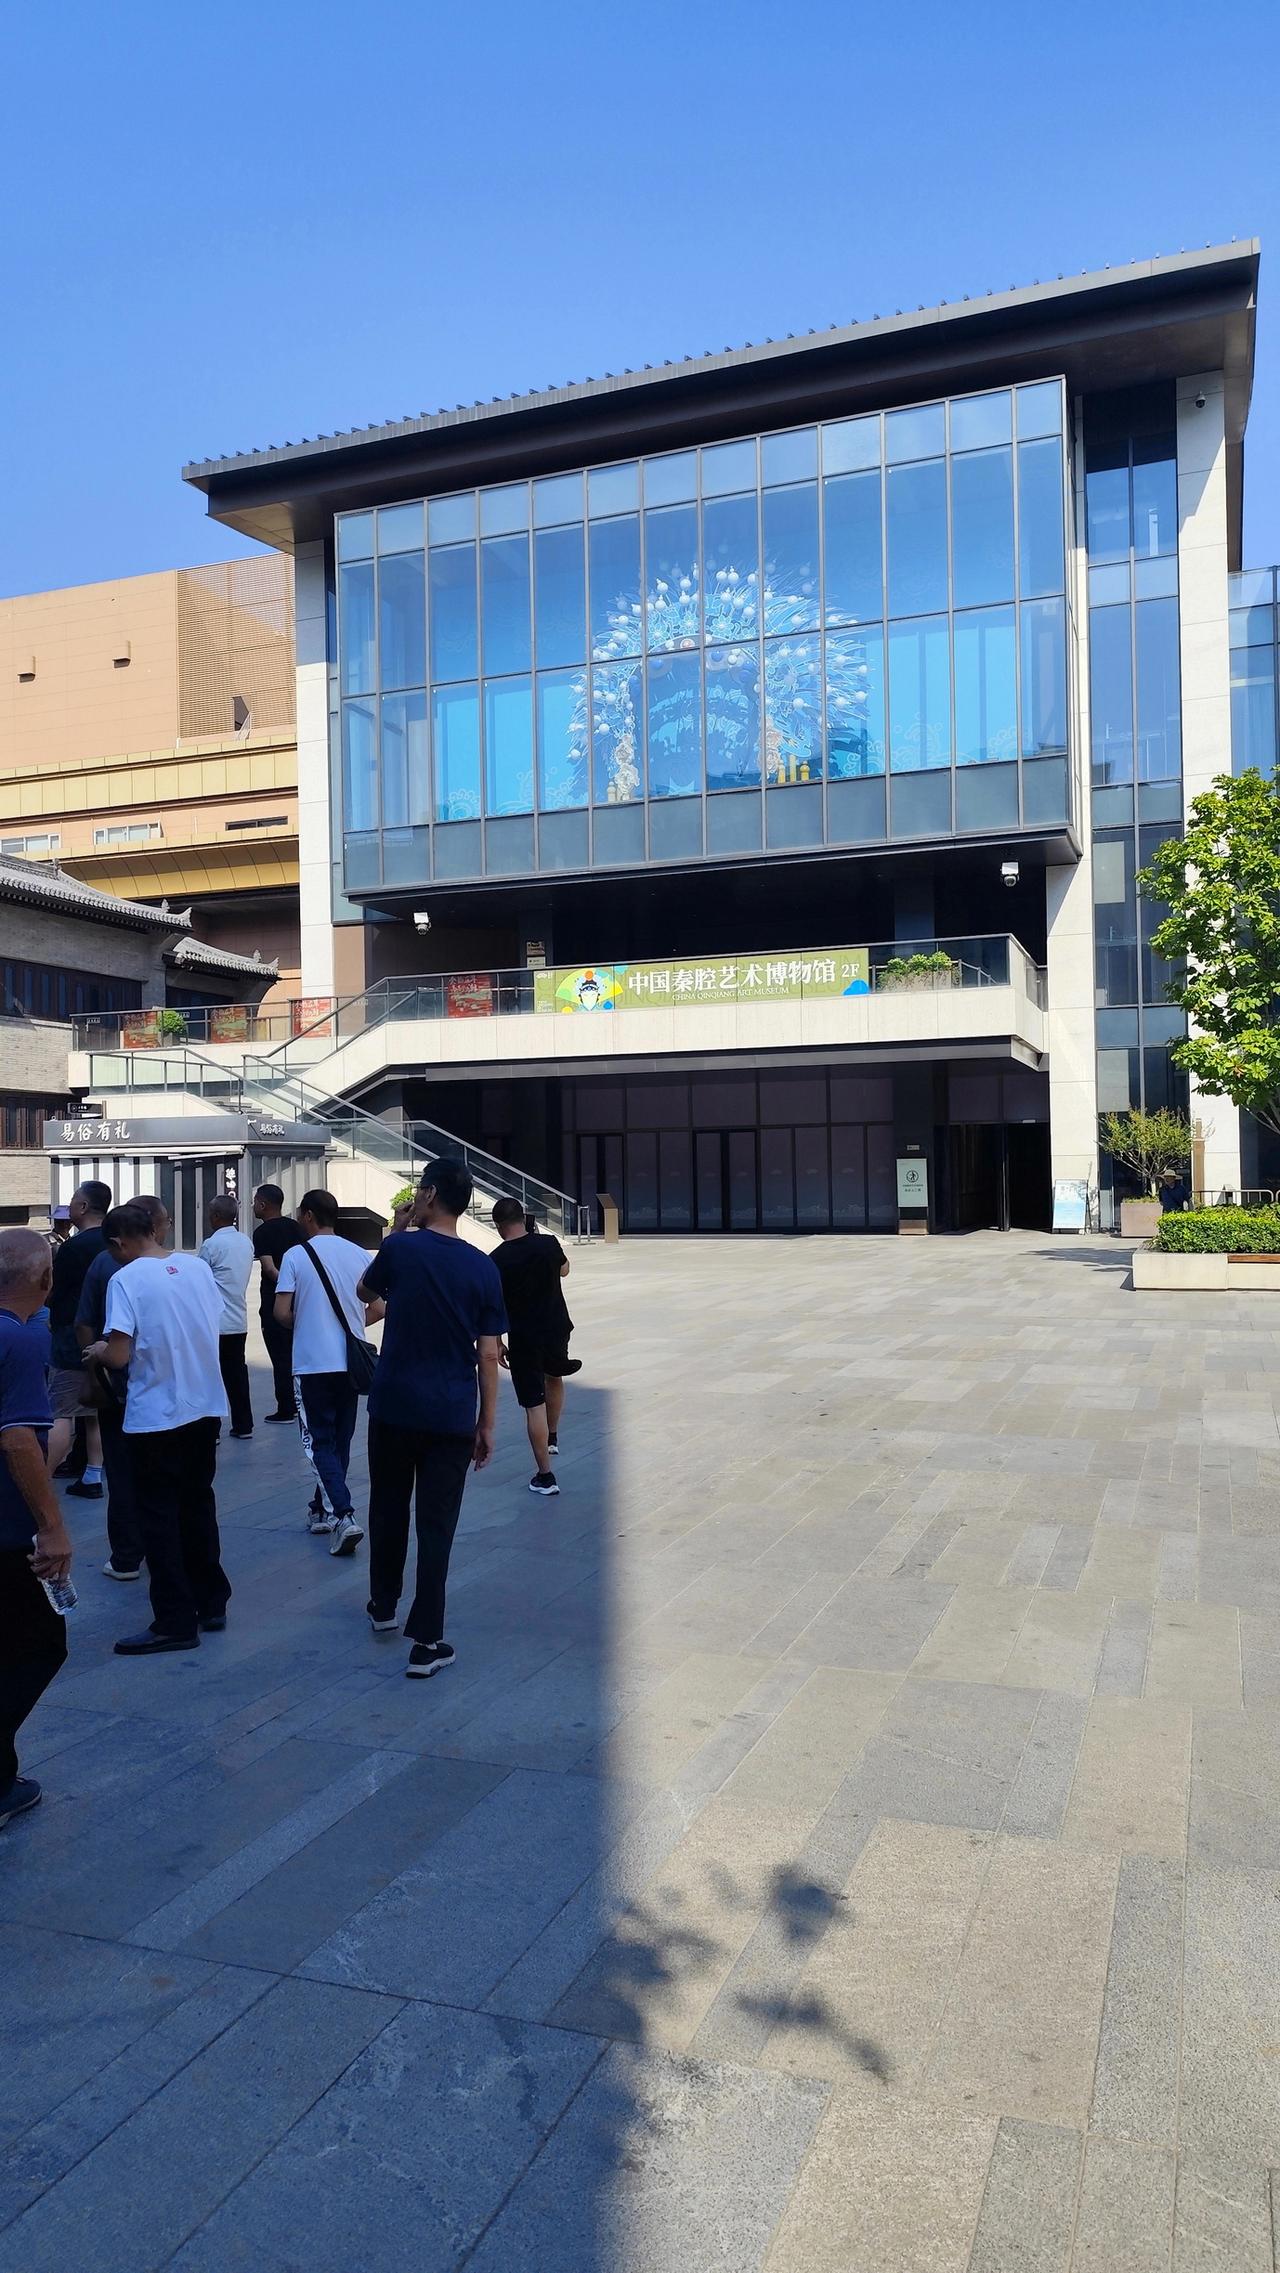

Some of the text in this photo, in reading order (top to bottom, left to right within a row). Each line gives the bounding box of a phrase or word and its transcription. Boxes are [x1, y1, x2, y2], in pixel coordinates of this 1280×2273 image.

[628, 959, 860, 995] 中国秦腔艺术博物馆 2F
[672, 986, 790, 1001] CHINA QINQIANG ART MUSEUM
[60, 1121, 131, 1142] 易俗有礼
